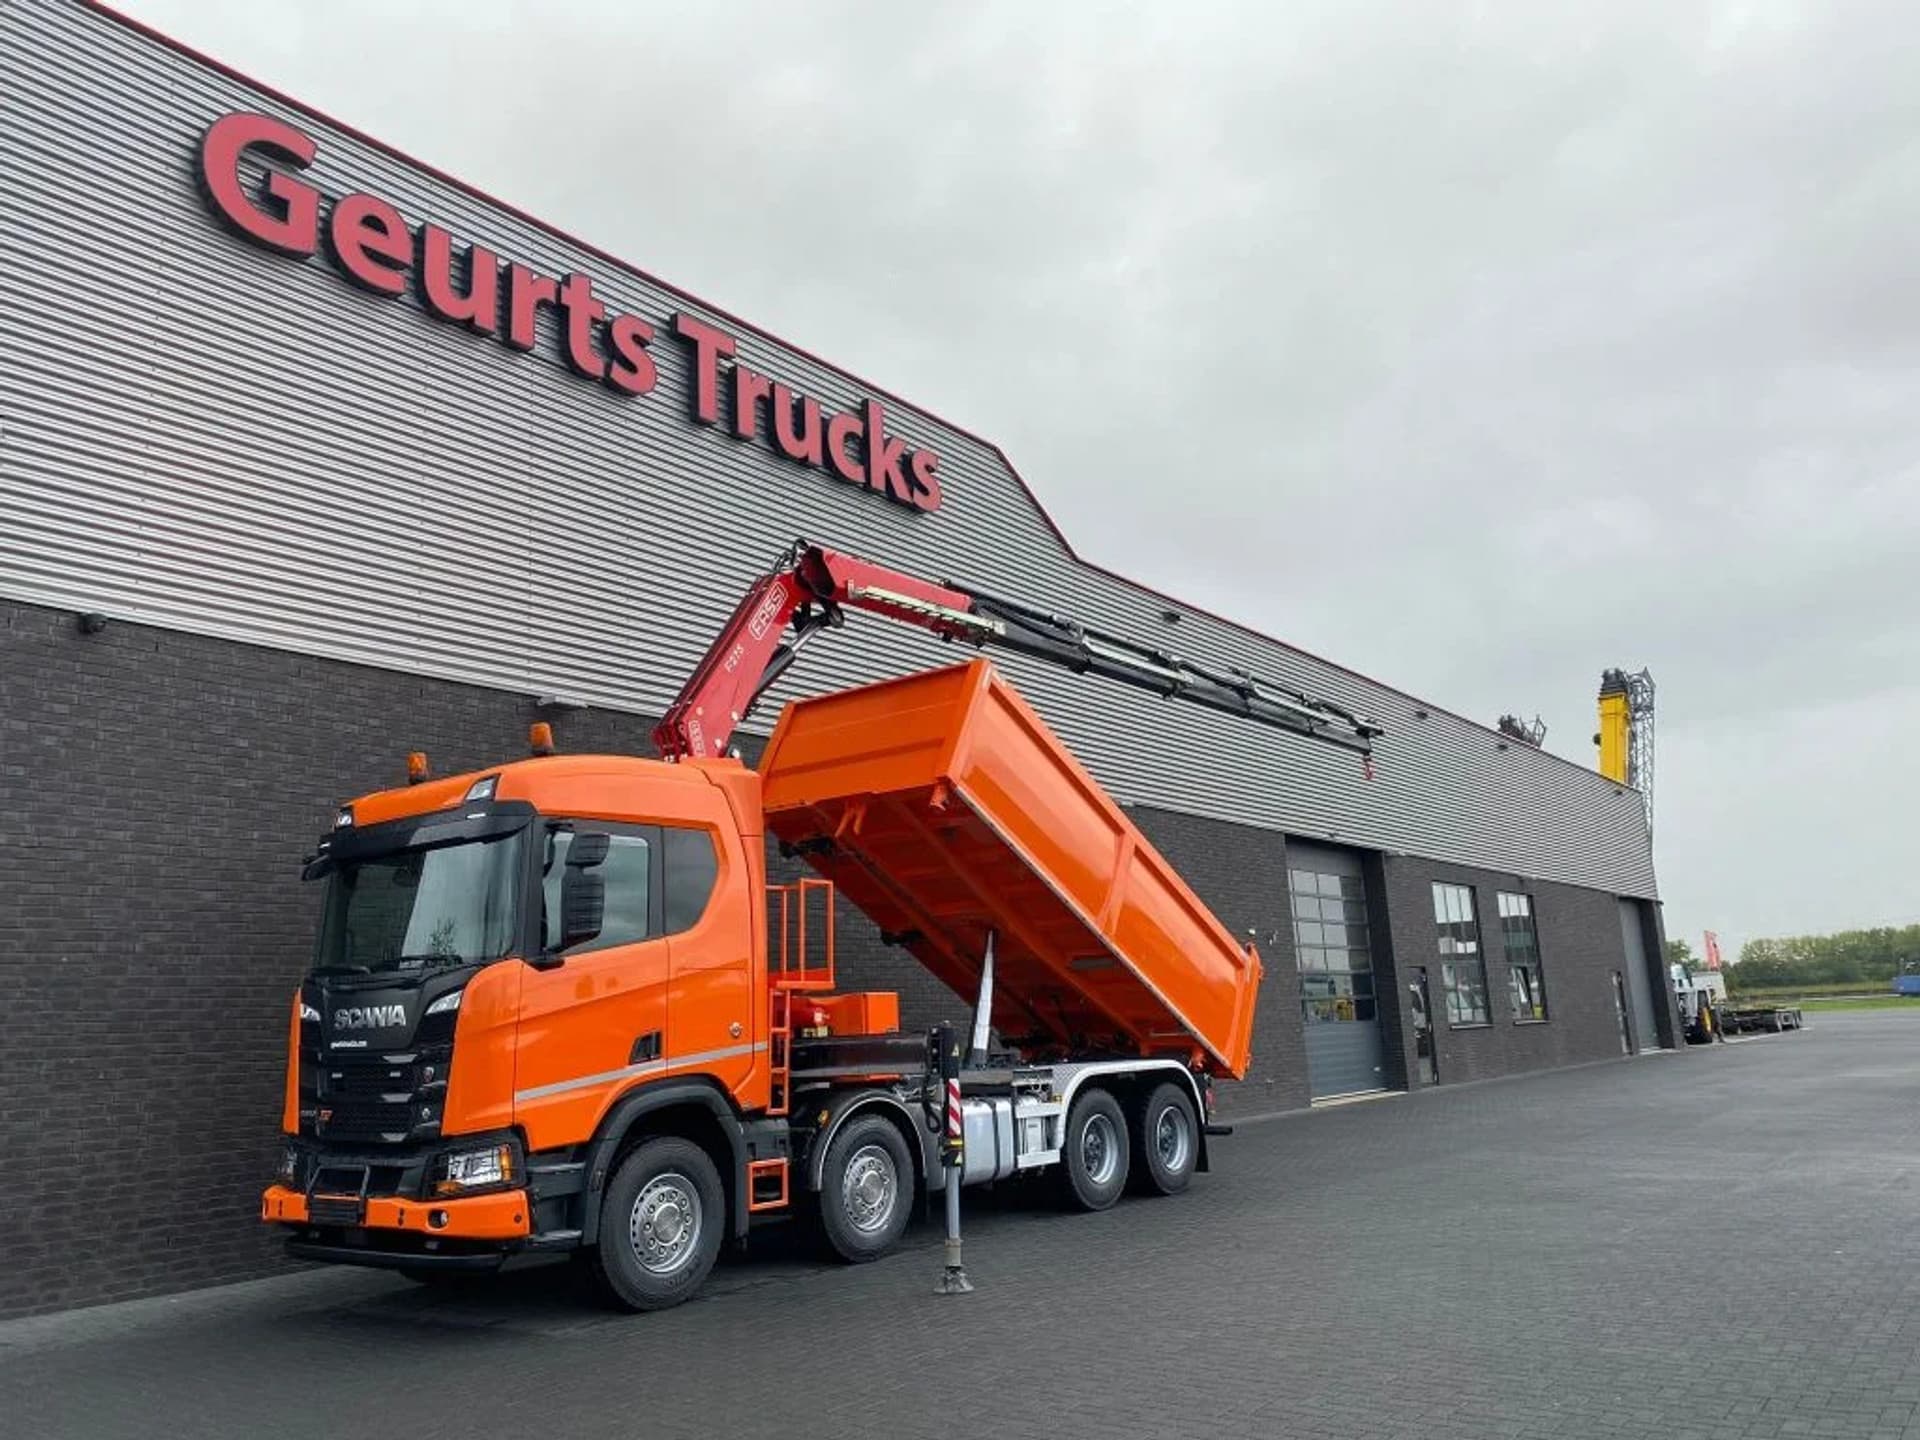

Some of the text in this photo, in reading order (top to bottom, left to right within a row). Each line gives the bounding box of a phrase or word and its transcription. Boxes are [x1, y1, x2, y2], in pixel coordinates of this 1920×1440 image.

[202, 112, 943, 512] Geurts Trucks
[334, 1005, 406, 1030] SCANIA
